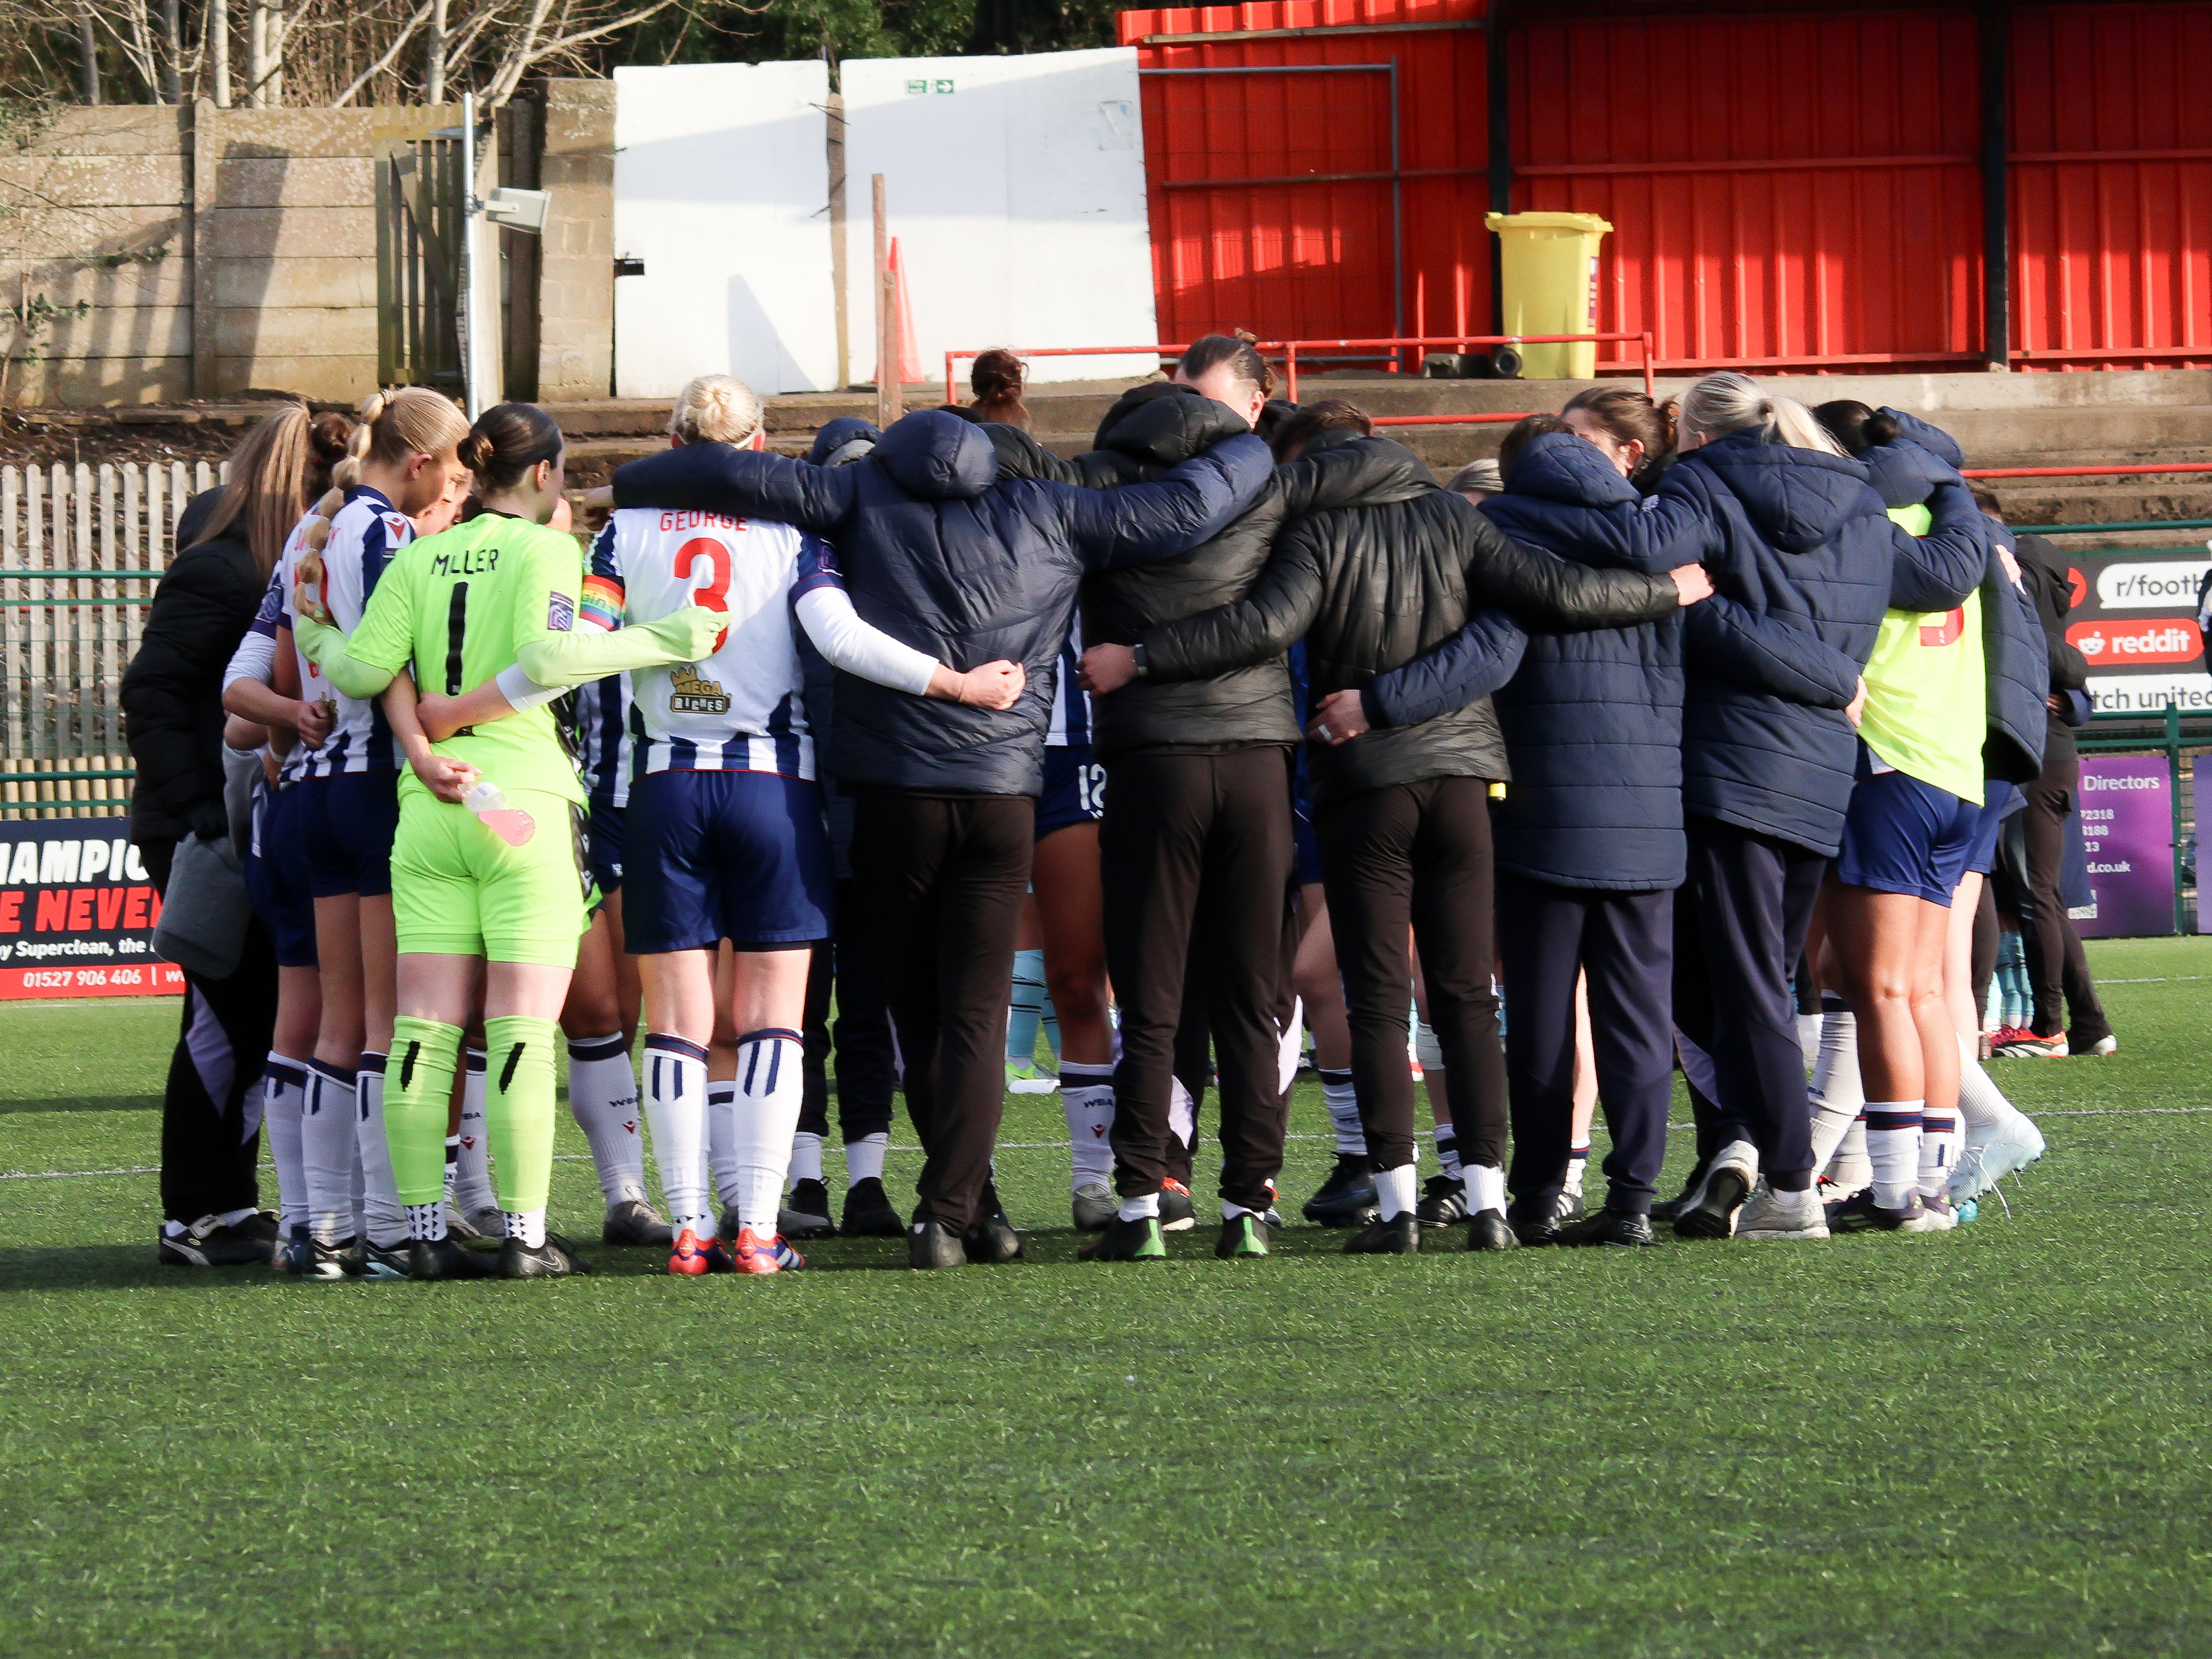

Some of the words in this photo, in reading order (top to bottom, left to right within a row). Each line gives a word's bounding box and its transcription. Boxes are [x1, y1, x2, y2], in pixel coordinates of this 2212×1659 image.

[660, 508, 748, 532] GEORGE
[429, 549, 499, 576] MLLER
[446, 581, 469, 697] 1
[2112, 628, 2190, 654] reddit
[1078, 763, 1108, 819] 12
[2083, 774, 2161, 792] Directors
[0, 944, 13, 961] y
[15, 939, 115, 960] Superclean,
[118, 937, 146, 953] the
[23, 970, 73, 988] 01527
[76, 970, 107, 986] 906
[109, 969, 142, 985] 406
